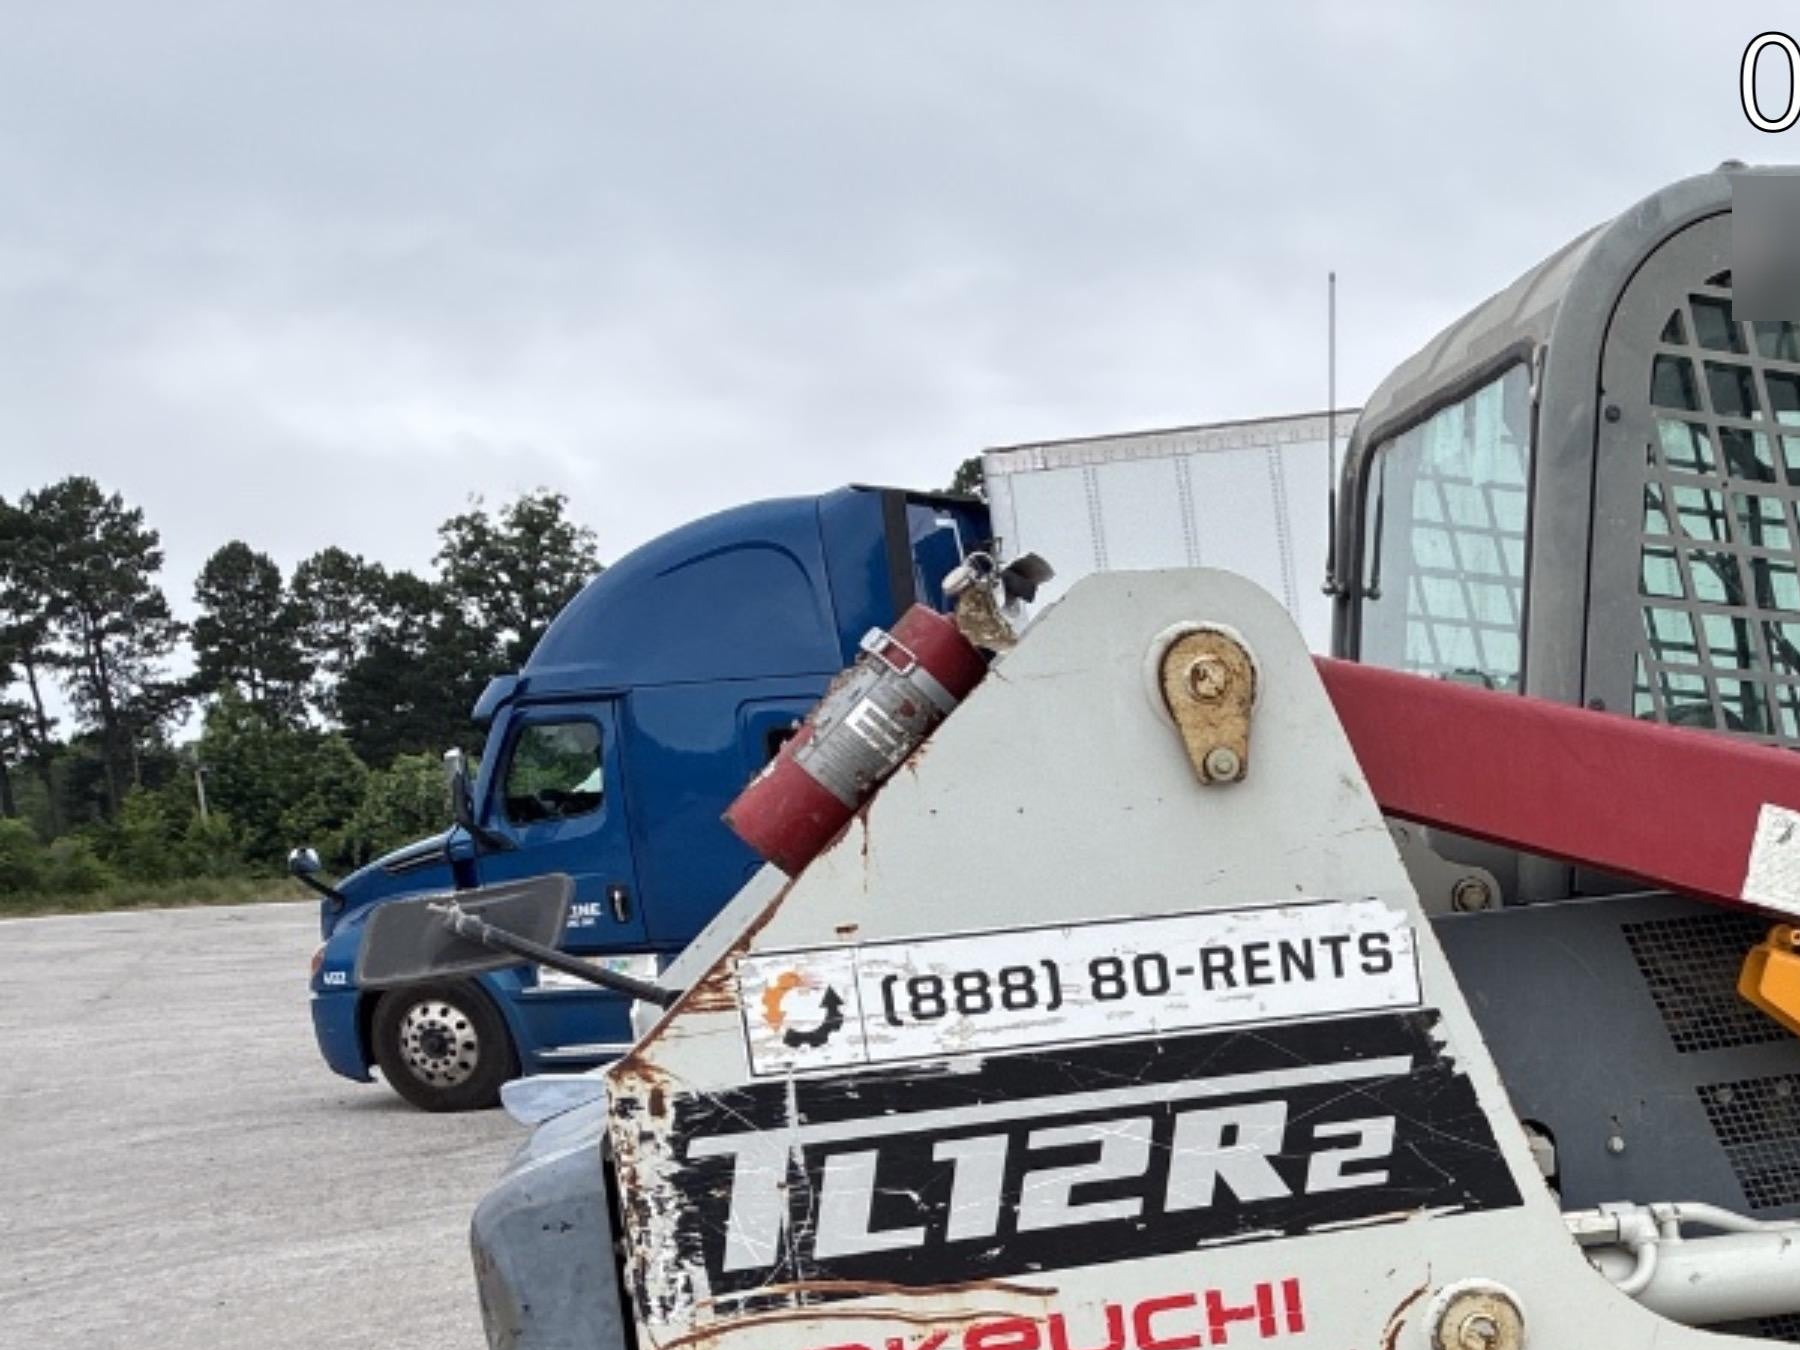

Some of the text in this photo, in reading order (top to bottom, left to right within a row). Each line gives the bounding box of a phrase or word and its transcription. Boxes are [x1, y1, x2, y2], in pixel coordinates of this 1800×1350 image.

[881, 931, 1394, 1026] (888) 80-RENTS
[687, 1099, 1397, 1274] TL12R2
